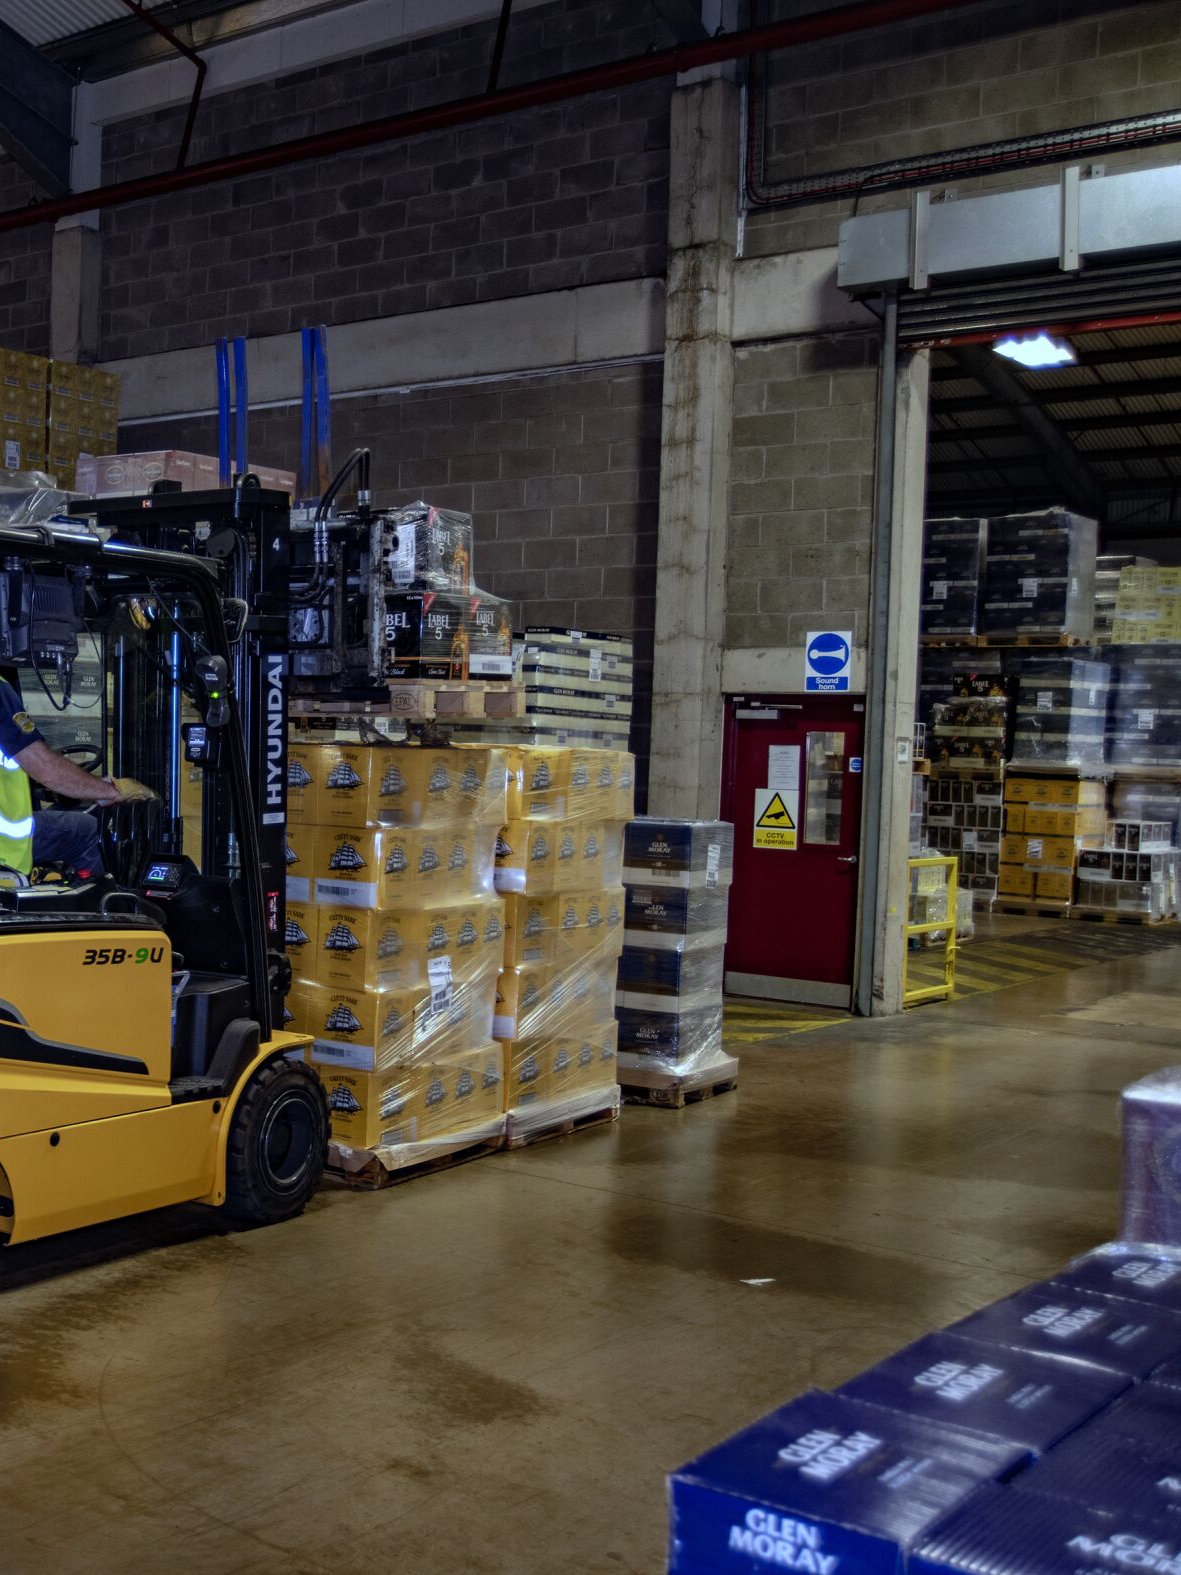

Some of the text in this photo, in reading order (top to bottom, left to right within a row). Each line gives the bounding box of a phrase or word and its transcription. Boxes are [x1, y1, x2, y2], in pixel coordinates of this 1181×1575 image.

[272, 538, 280, 550] 4
[432, 528, 451, 545] LABEL
[439, 543, 445, 556] 5
[386, 612, 411, 629] BEL
[428, 613, 451, 629] LABEL
[476, 611, 496, 626] LABEL
[386, 626, 396, 641] 5
[435, 627, 442, 640] 5
[482, 625, 489, 637] 5
[395, 696, 411, 706] EPAL
[267, 655, 283, 804] HYUNDAI
[350, 834, 363, 842] SARK
[344, 915, 356, 924] SARK
[83, 947, 164, 965] 35B-9U
[346, 996, 357, 1006] SARK
[345, 1076, 356, 1086] SARK
[1112, 1261, 1152, 1278] GLEN
[1022, 1305, 1069, 1326] GLEN
[1043, 1307, 1105, 1337] MORAY
[914, 1361, 968, 1386] GLEN
[936, 1363, 1004, 1400] MORAY
[778, 1429, 842, 1462] GLEN
[799, 1431, 882, 1479] MORAY
[745, 1508, 818, 1548] GLEN
[729, 1525, 836, 1575] MORAY
